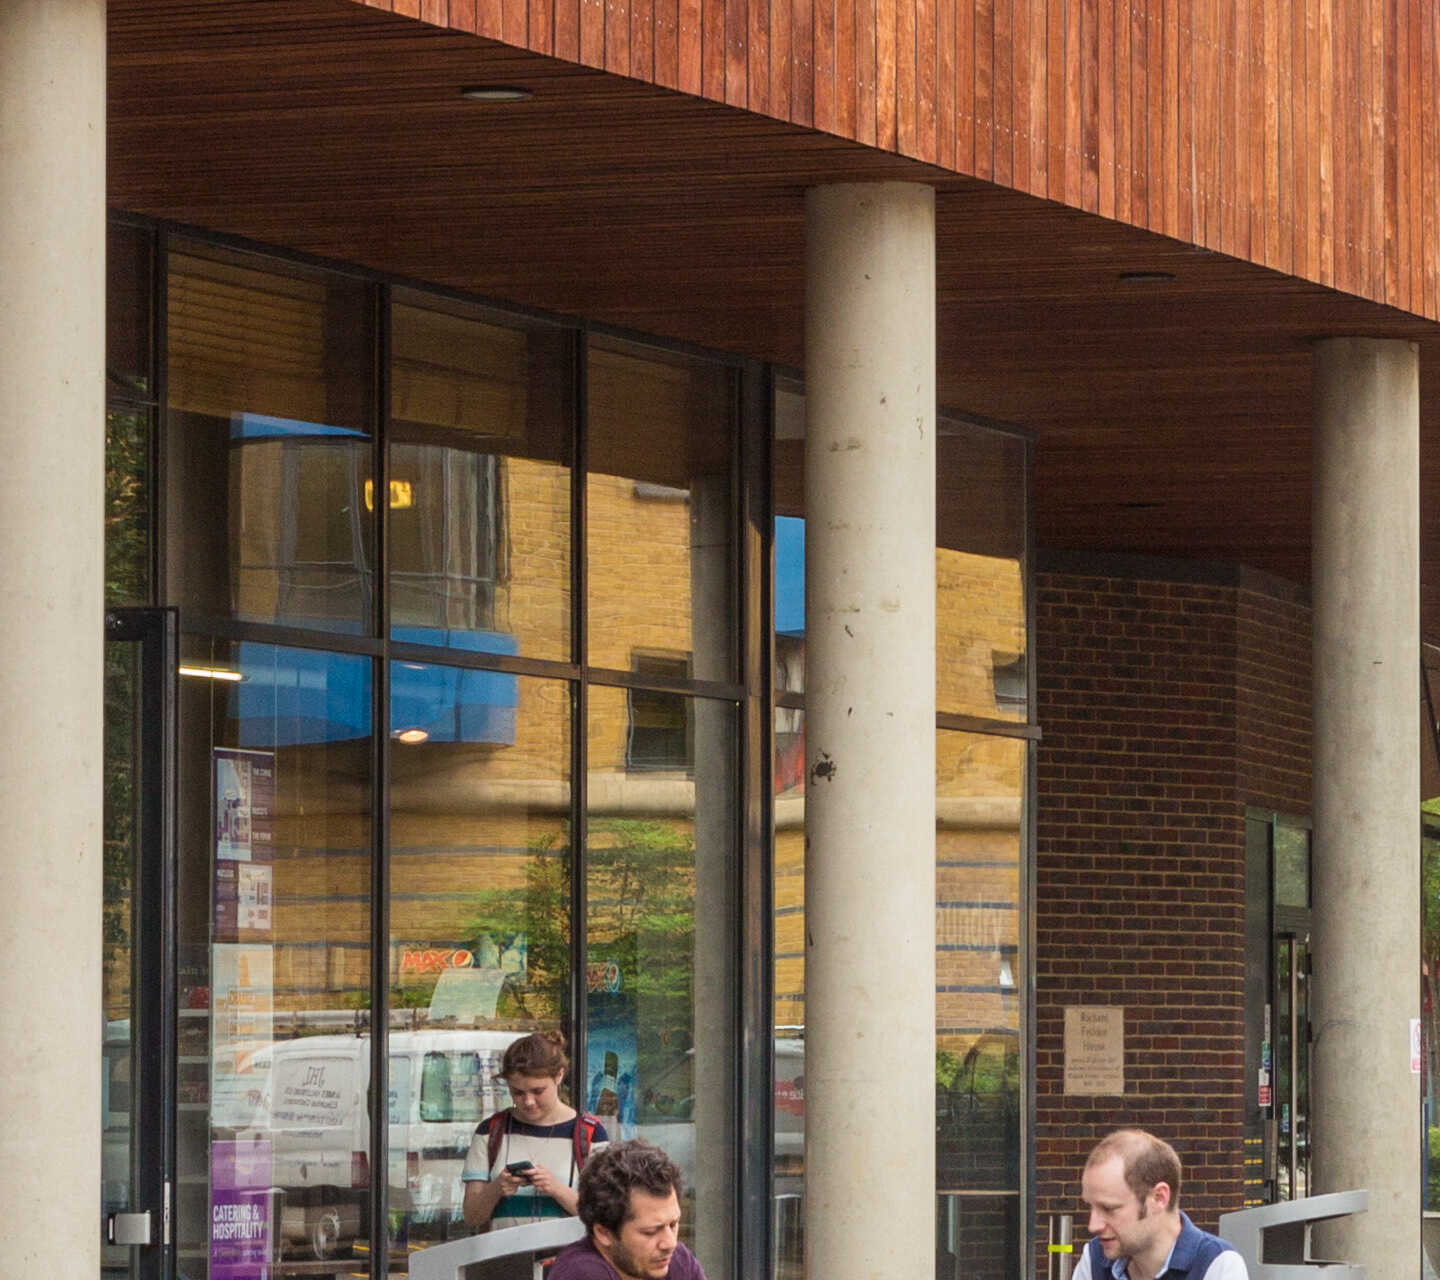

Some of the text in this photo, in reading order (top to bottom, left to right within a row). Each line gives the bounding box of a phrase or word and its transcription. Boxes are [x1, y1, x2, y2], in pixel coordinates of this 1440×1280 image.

[213, 1204, 259, 1222] CATERING &
[213, 1221, 264, 1240] HOSPITALITY
